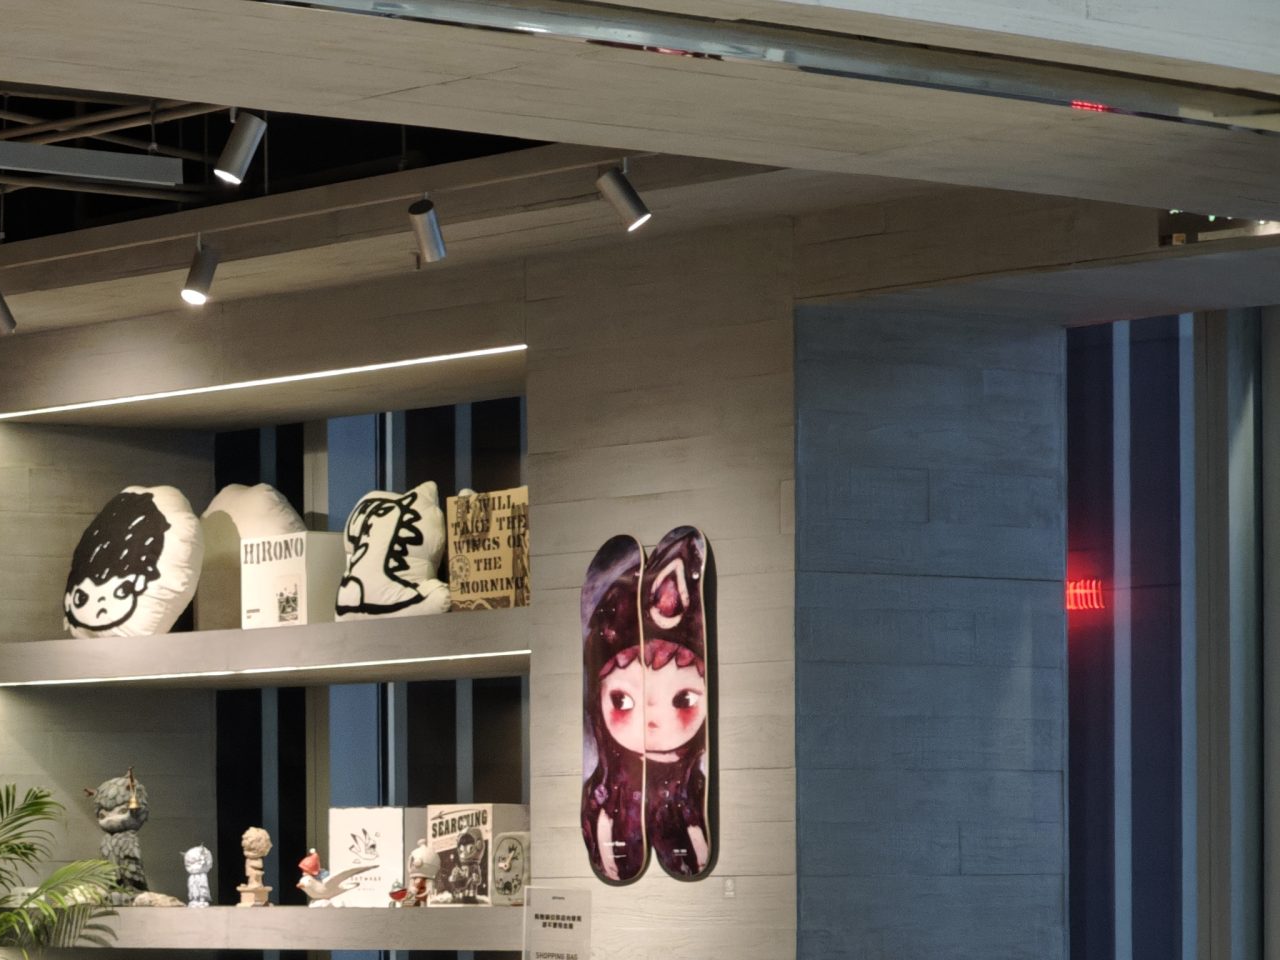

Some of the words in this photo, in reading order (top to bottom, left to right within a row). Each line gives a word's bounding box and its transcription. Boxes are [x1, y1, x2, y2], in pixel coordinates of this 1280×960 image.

[496, 514, 526, 531] THE
[243, 537, 304, 565] HIRONO
[453, 536, 500, 555] WINGS
[474, 557, 502, 572] THE
[460, 576, 525, 595] MORNING
[535, 951, 565, 960] SHOPPING
[566, 953, 578, 960] BAG
